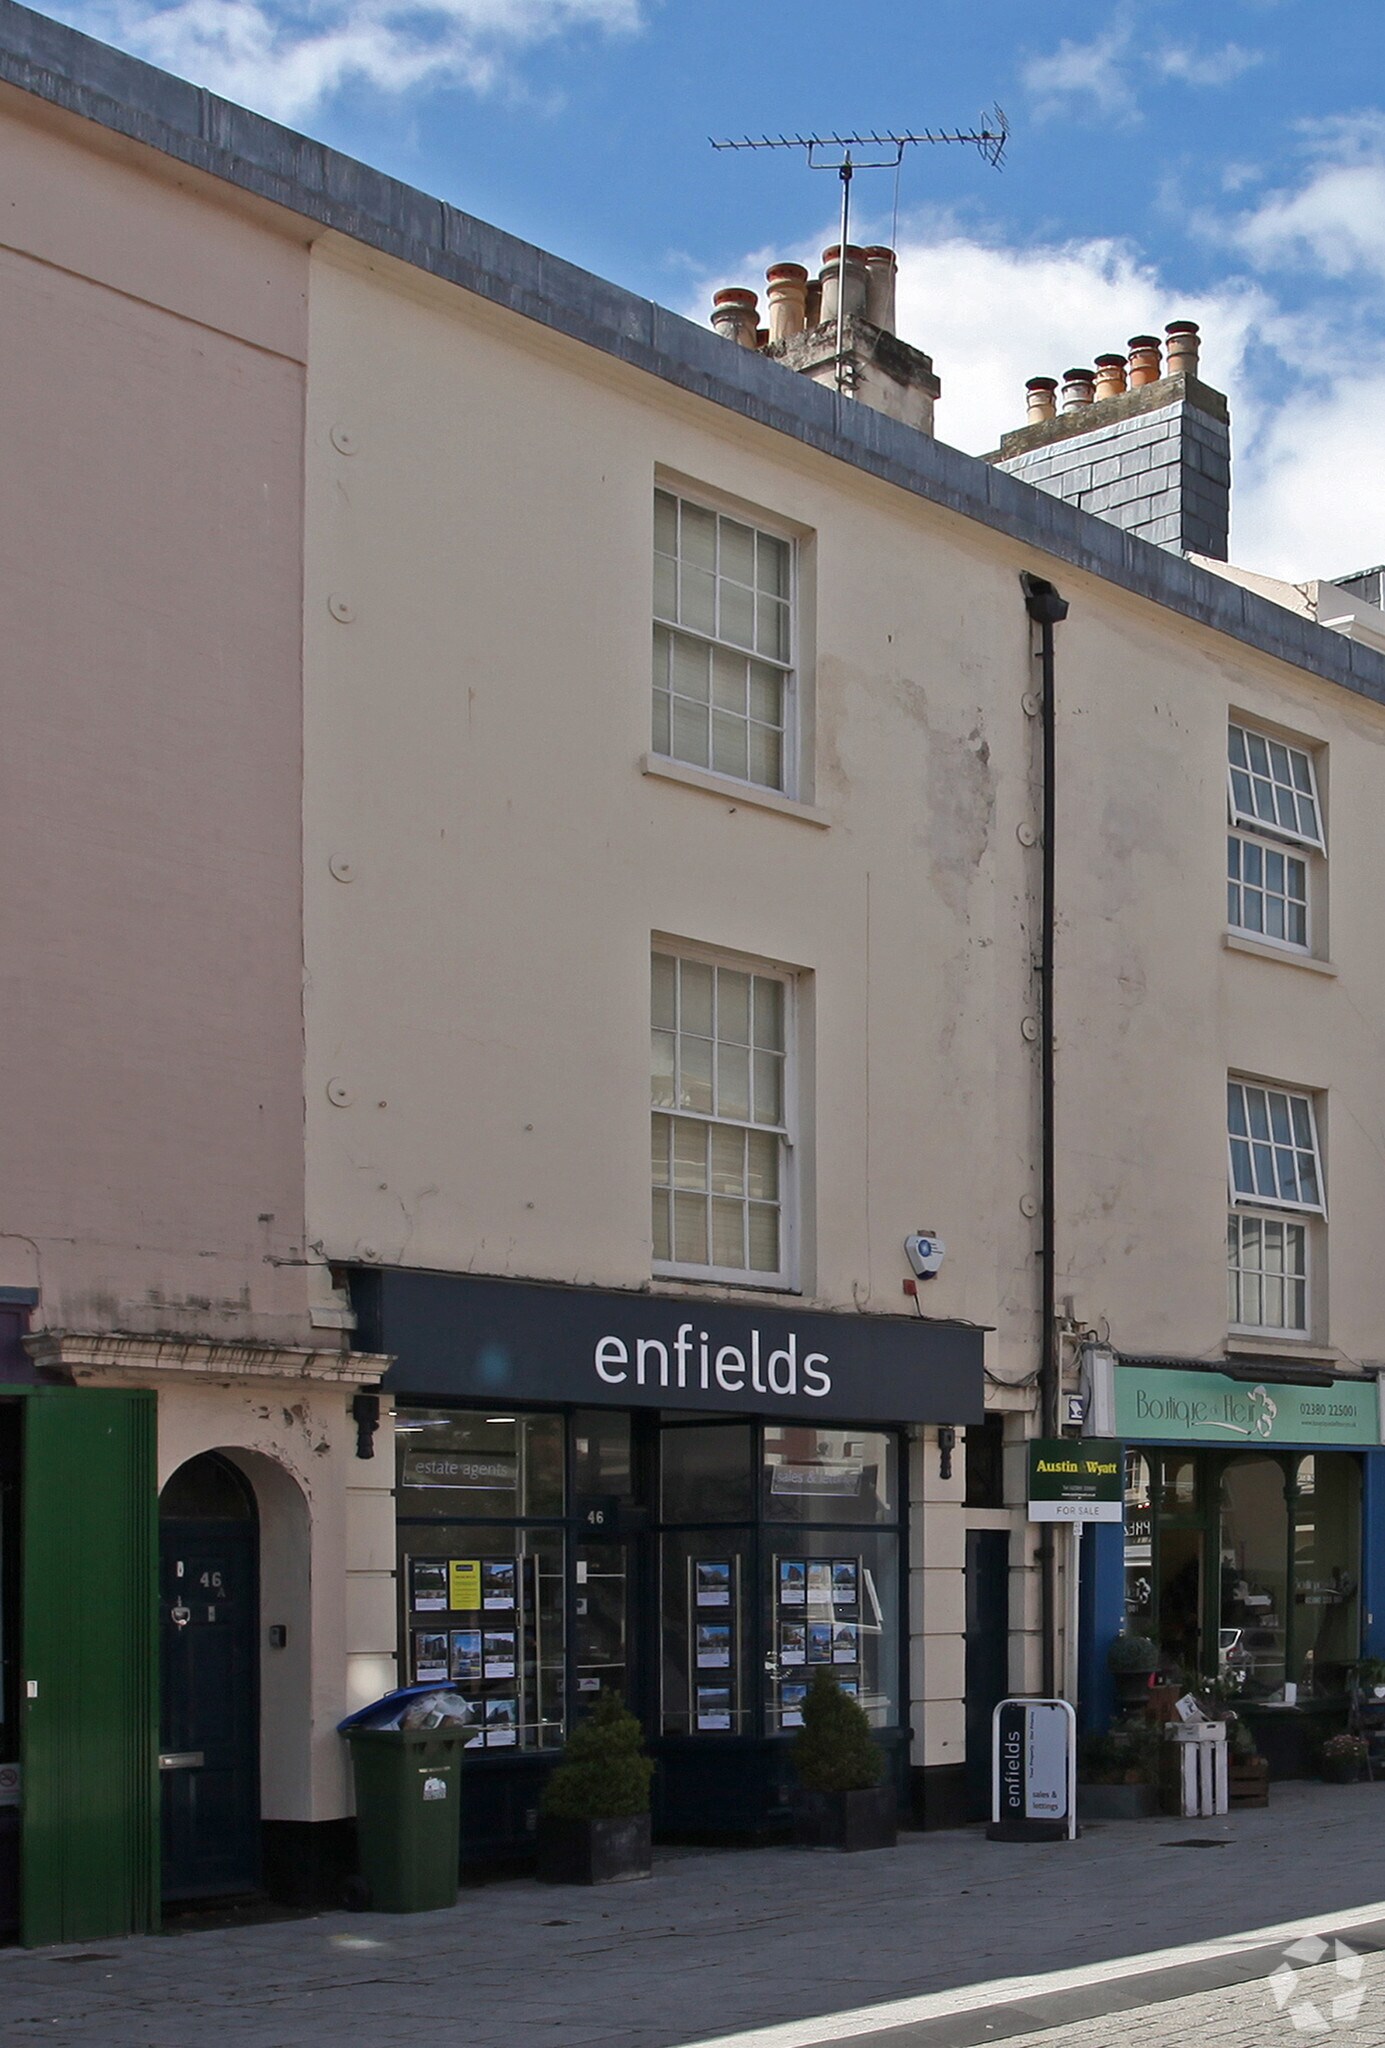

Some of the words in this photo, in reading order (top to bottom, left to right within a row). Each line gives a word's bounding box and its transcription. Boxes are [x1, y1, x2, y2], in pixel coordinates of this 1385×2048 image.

[594, 1323, 832, 1397] enfields
[1300, 1403, 1327, 1415] 02380
[1328, 1404, 1357, 1417] 225001
[415, 1460, 459, 1475] estate
[462, 1463, 508, 1480] agents
[1036, 1459, 1079, 1473] Austin
[1085, 1461, 1117, 1476] Wyatt
[776, 1469, 804, 1483] sales
[806, 1470, 816, 1484] &
[586, 1509, 604, 1525] 46
[1056, 1506, 1075, 1515] FOR
[1078, 1506, 1100, 1515] SALE
[199, 1572, 222, 1587] 46
[1004, 1731, 1021, 1808] enfields
[1032, 1789, 1050, 1798] sales
[1051, 1790, 1057, 1798] &
